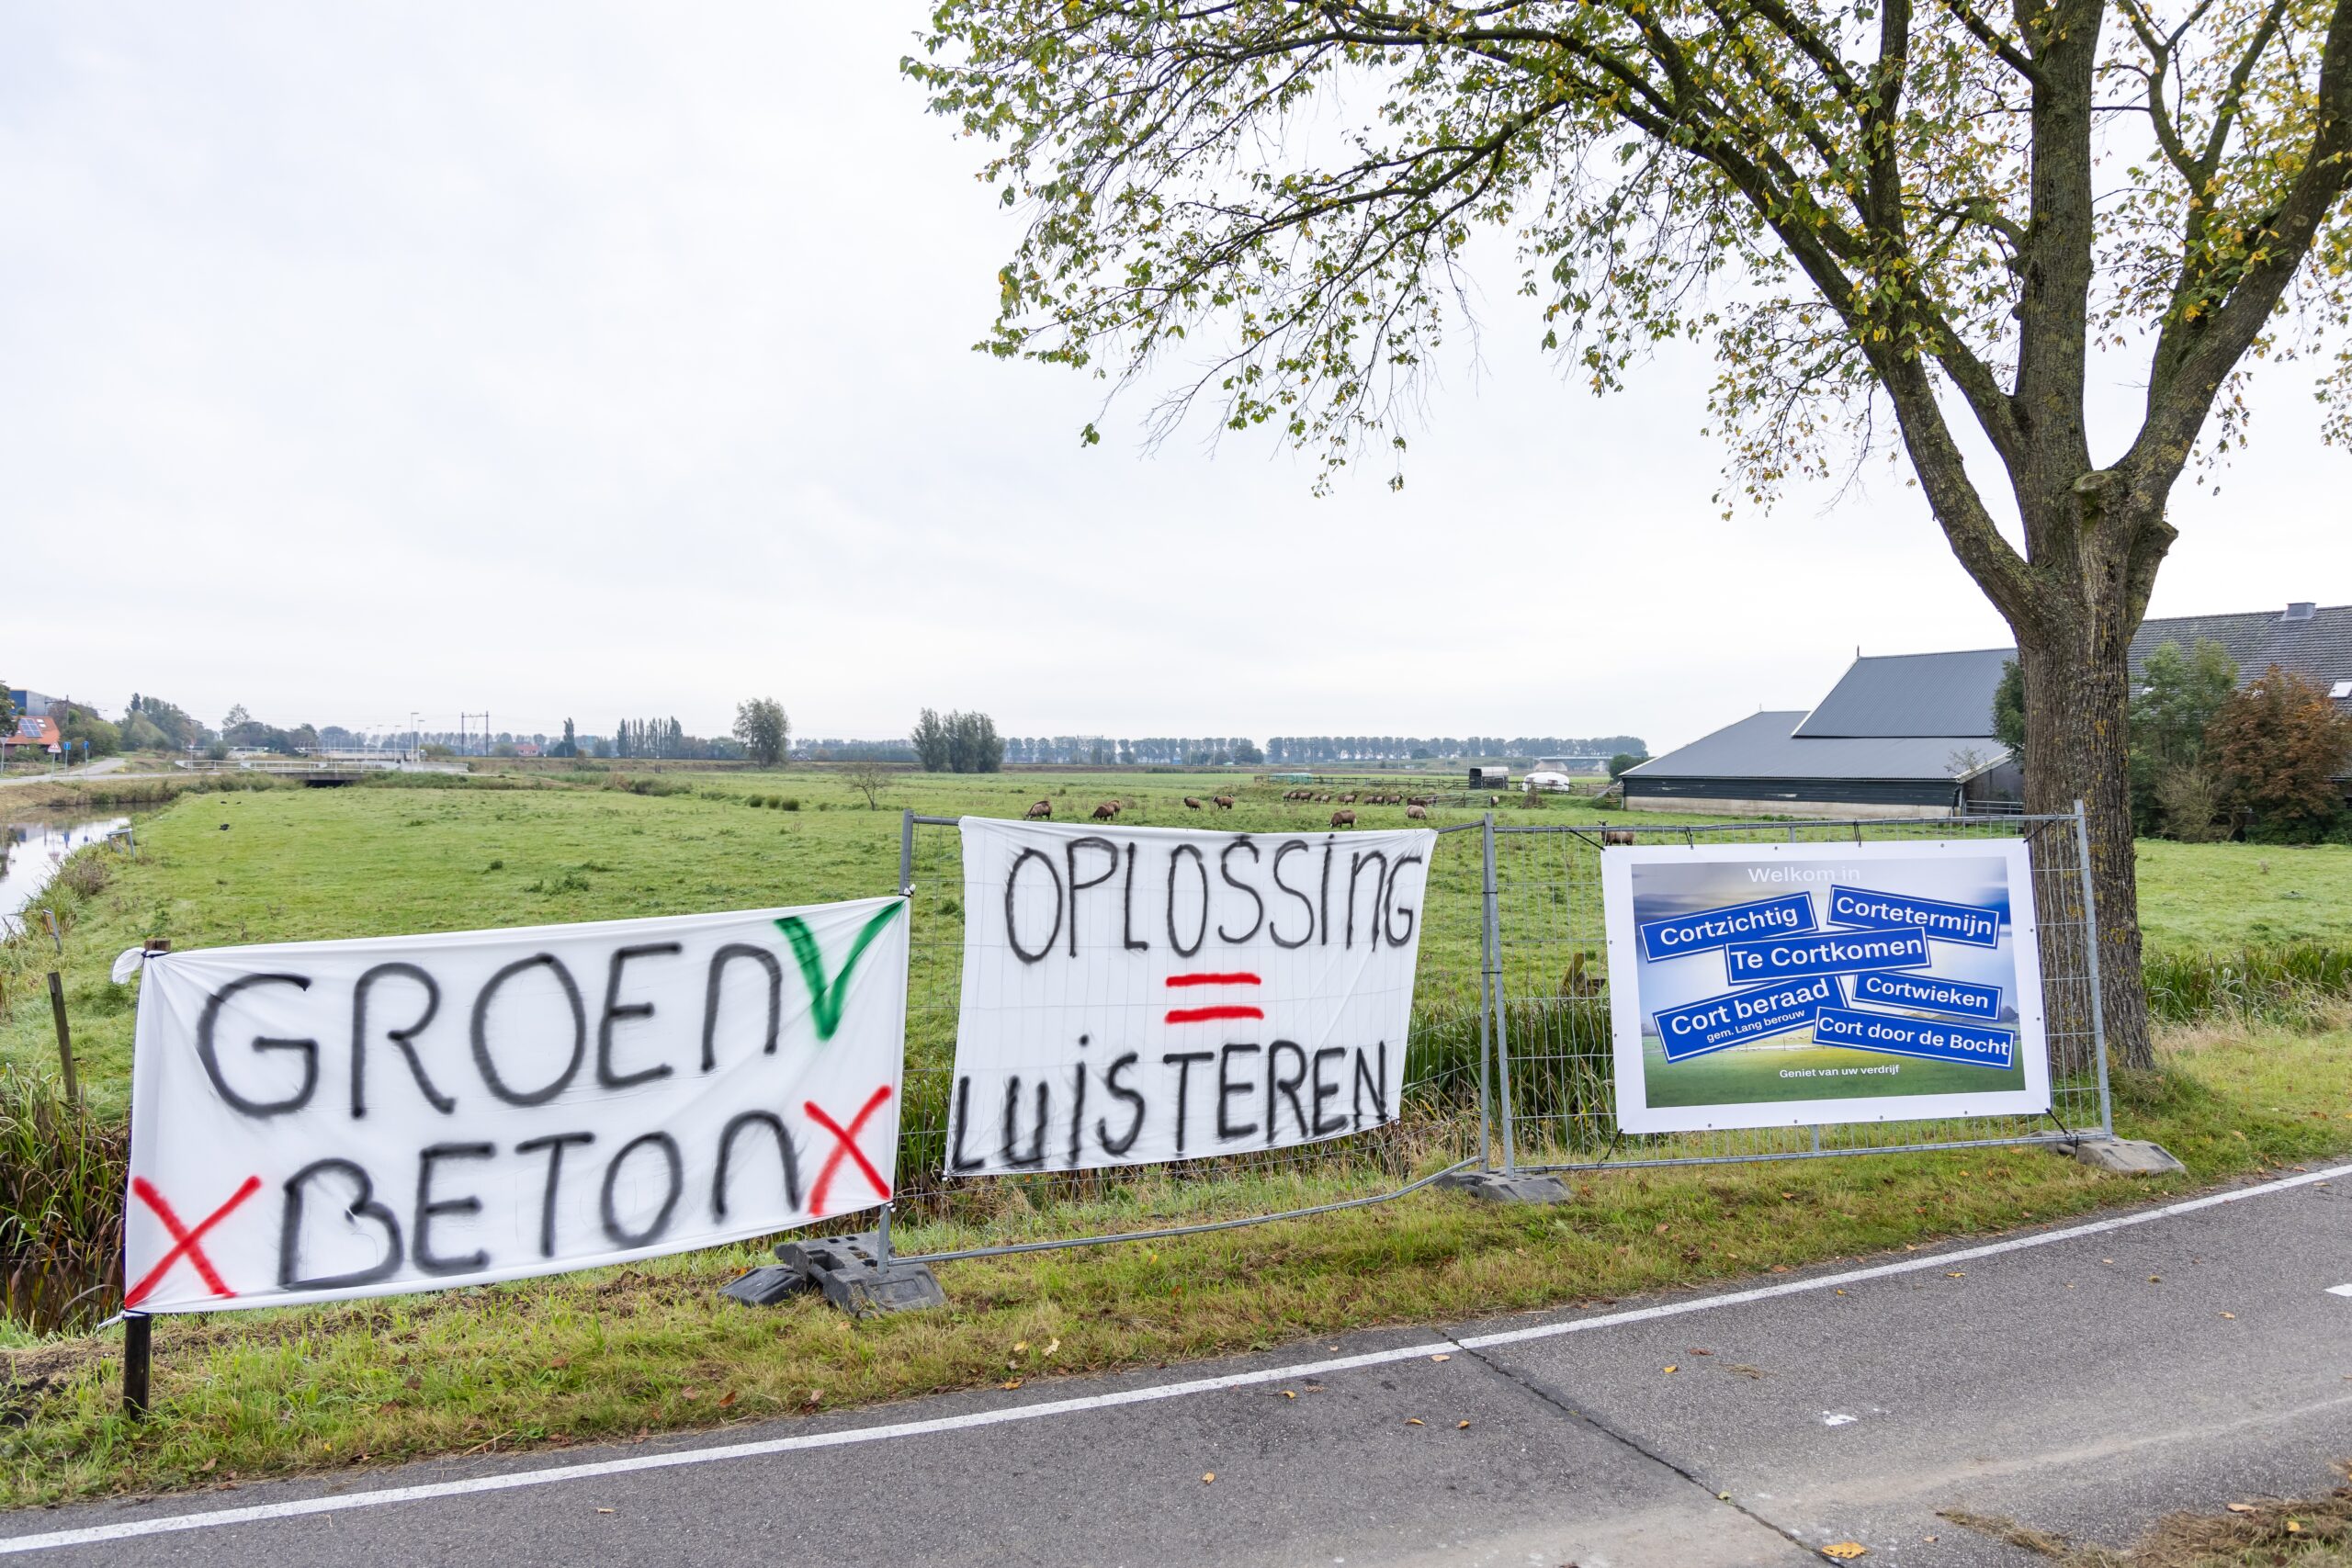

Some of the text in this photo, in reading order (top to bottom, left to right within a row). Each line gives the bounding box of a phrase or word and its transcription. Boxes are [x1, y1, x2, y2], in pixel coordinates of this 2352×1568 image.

[1747, 865, 1860, 883] Welkom in
[1660, 907, 1798, 945] Cortzichtig
[1837, 897, 1992, 937] Cortetermijn
[1730, 939, 1923, 970] Te Cortkomen
[1671, 977, 1830, 1035] Cort beraad
[1866, 977, 1989, 1009] Cortwieken
[1706, 1010, 1805, 1043] gem. Lang berouw
[1819, 1017, 2009, 1056] Cort door de Bocht
[1779, 1065, 1900, 1078] Geniet van uw verdrijf
